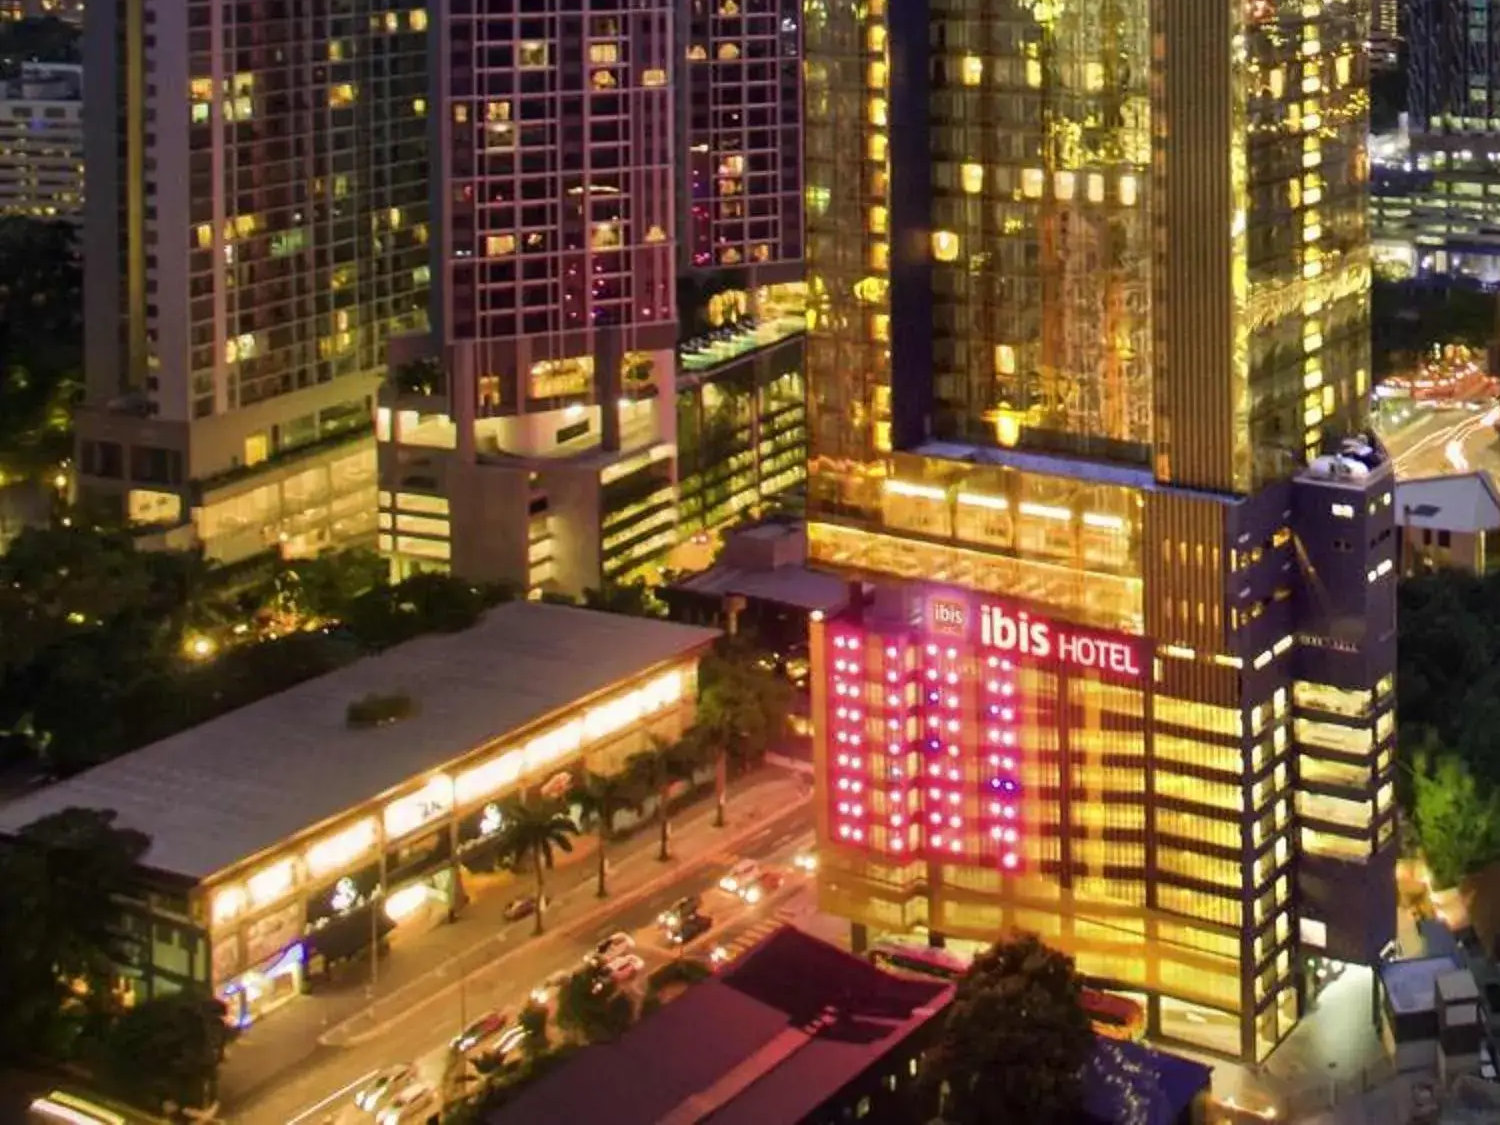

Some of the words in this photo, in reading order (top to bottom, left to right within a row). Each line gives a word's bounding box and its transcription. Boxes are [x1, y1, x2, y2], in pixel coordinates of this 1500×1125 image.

[935, 602, 964, 624] ibis
[981, 604, 1050, 656] ibis
[1059, 633, 1139, 674] HOTEL
